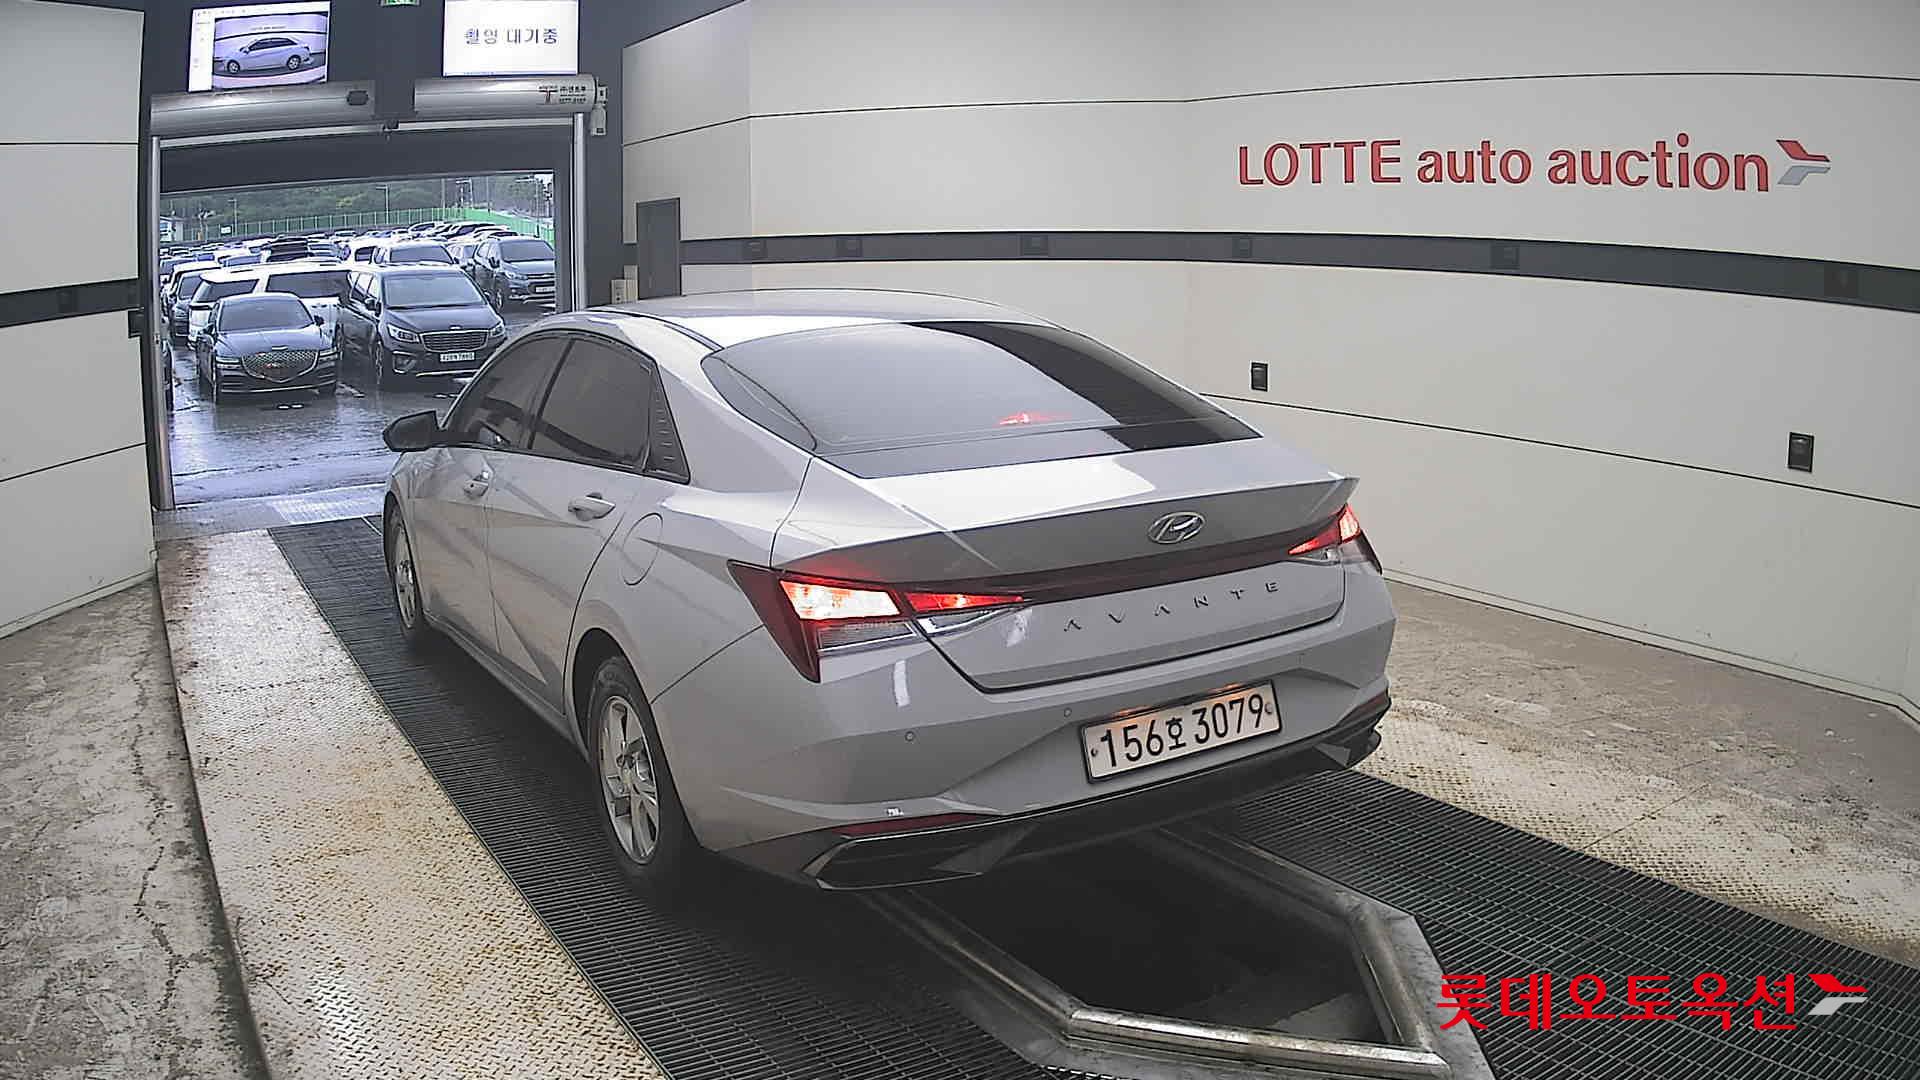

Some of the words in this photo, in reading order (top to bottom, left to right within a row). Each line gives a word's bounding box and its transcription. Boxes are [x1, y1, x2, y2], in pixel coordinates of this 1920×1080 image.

[506, 28, 558, 45] 대기중
[1238, 139, 1400, 186] LOTTE
[1416, 140, 1532, 184] auto
[1547, 132, 1770, 193] auction
[1063, 580, 1280, 633] AVANTE
[1191, 693, 1265, 744] 3079
